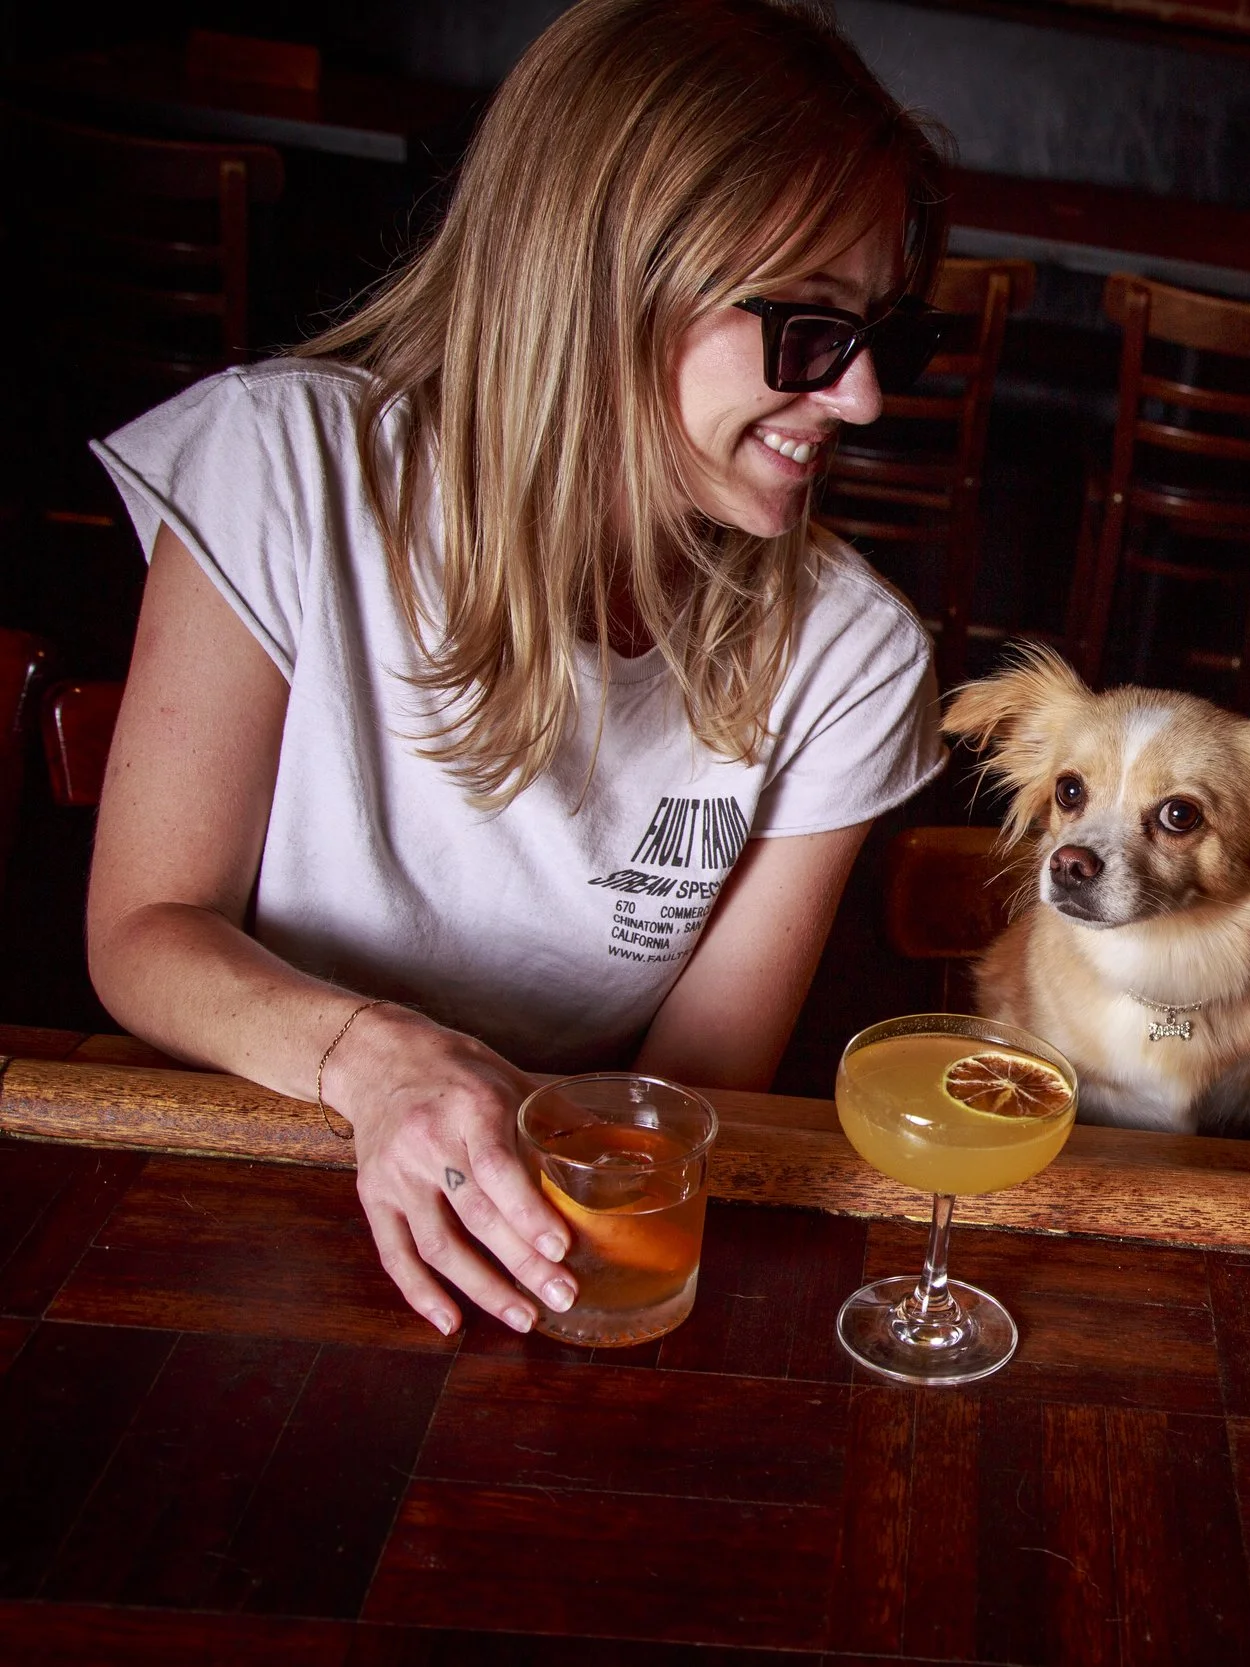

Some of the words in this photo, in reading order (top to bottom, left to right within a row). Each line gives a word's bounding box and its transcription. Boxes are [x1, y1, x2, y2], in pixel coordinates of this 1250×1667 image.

[631, 797, 700, 868] FAULT
[588, 869, 677, 897] STREAM
[615, 900, 636, 914] 670
[611, 926, 670, 949] CALIFORNIA
